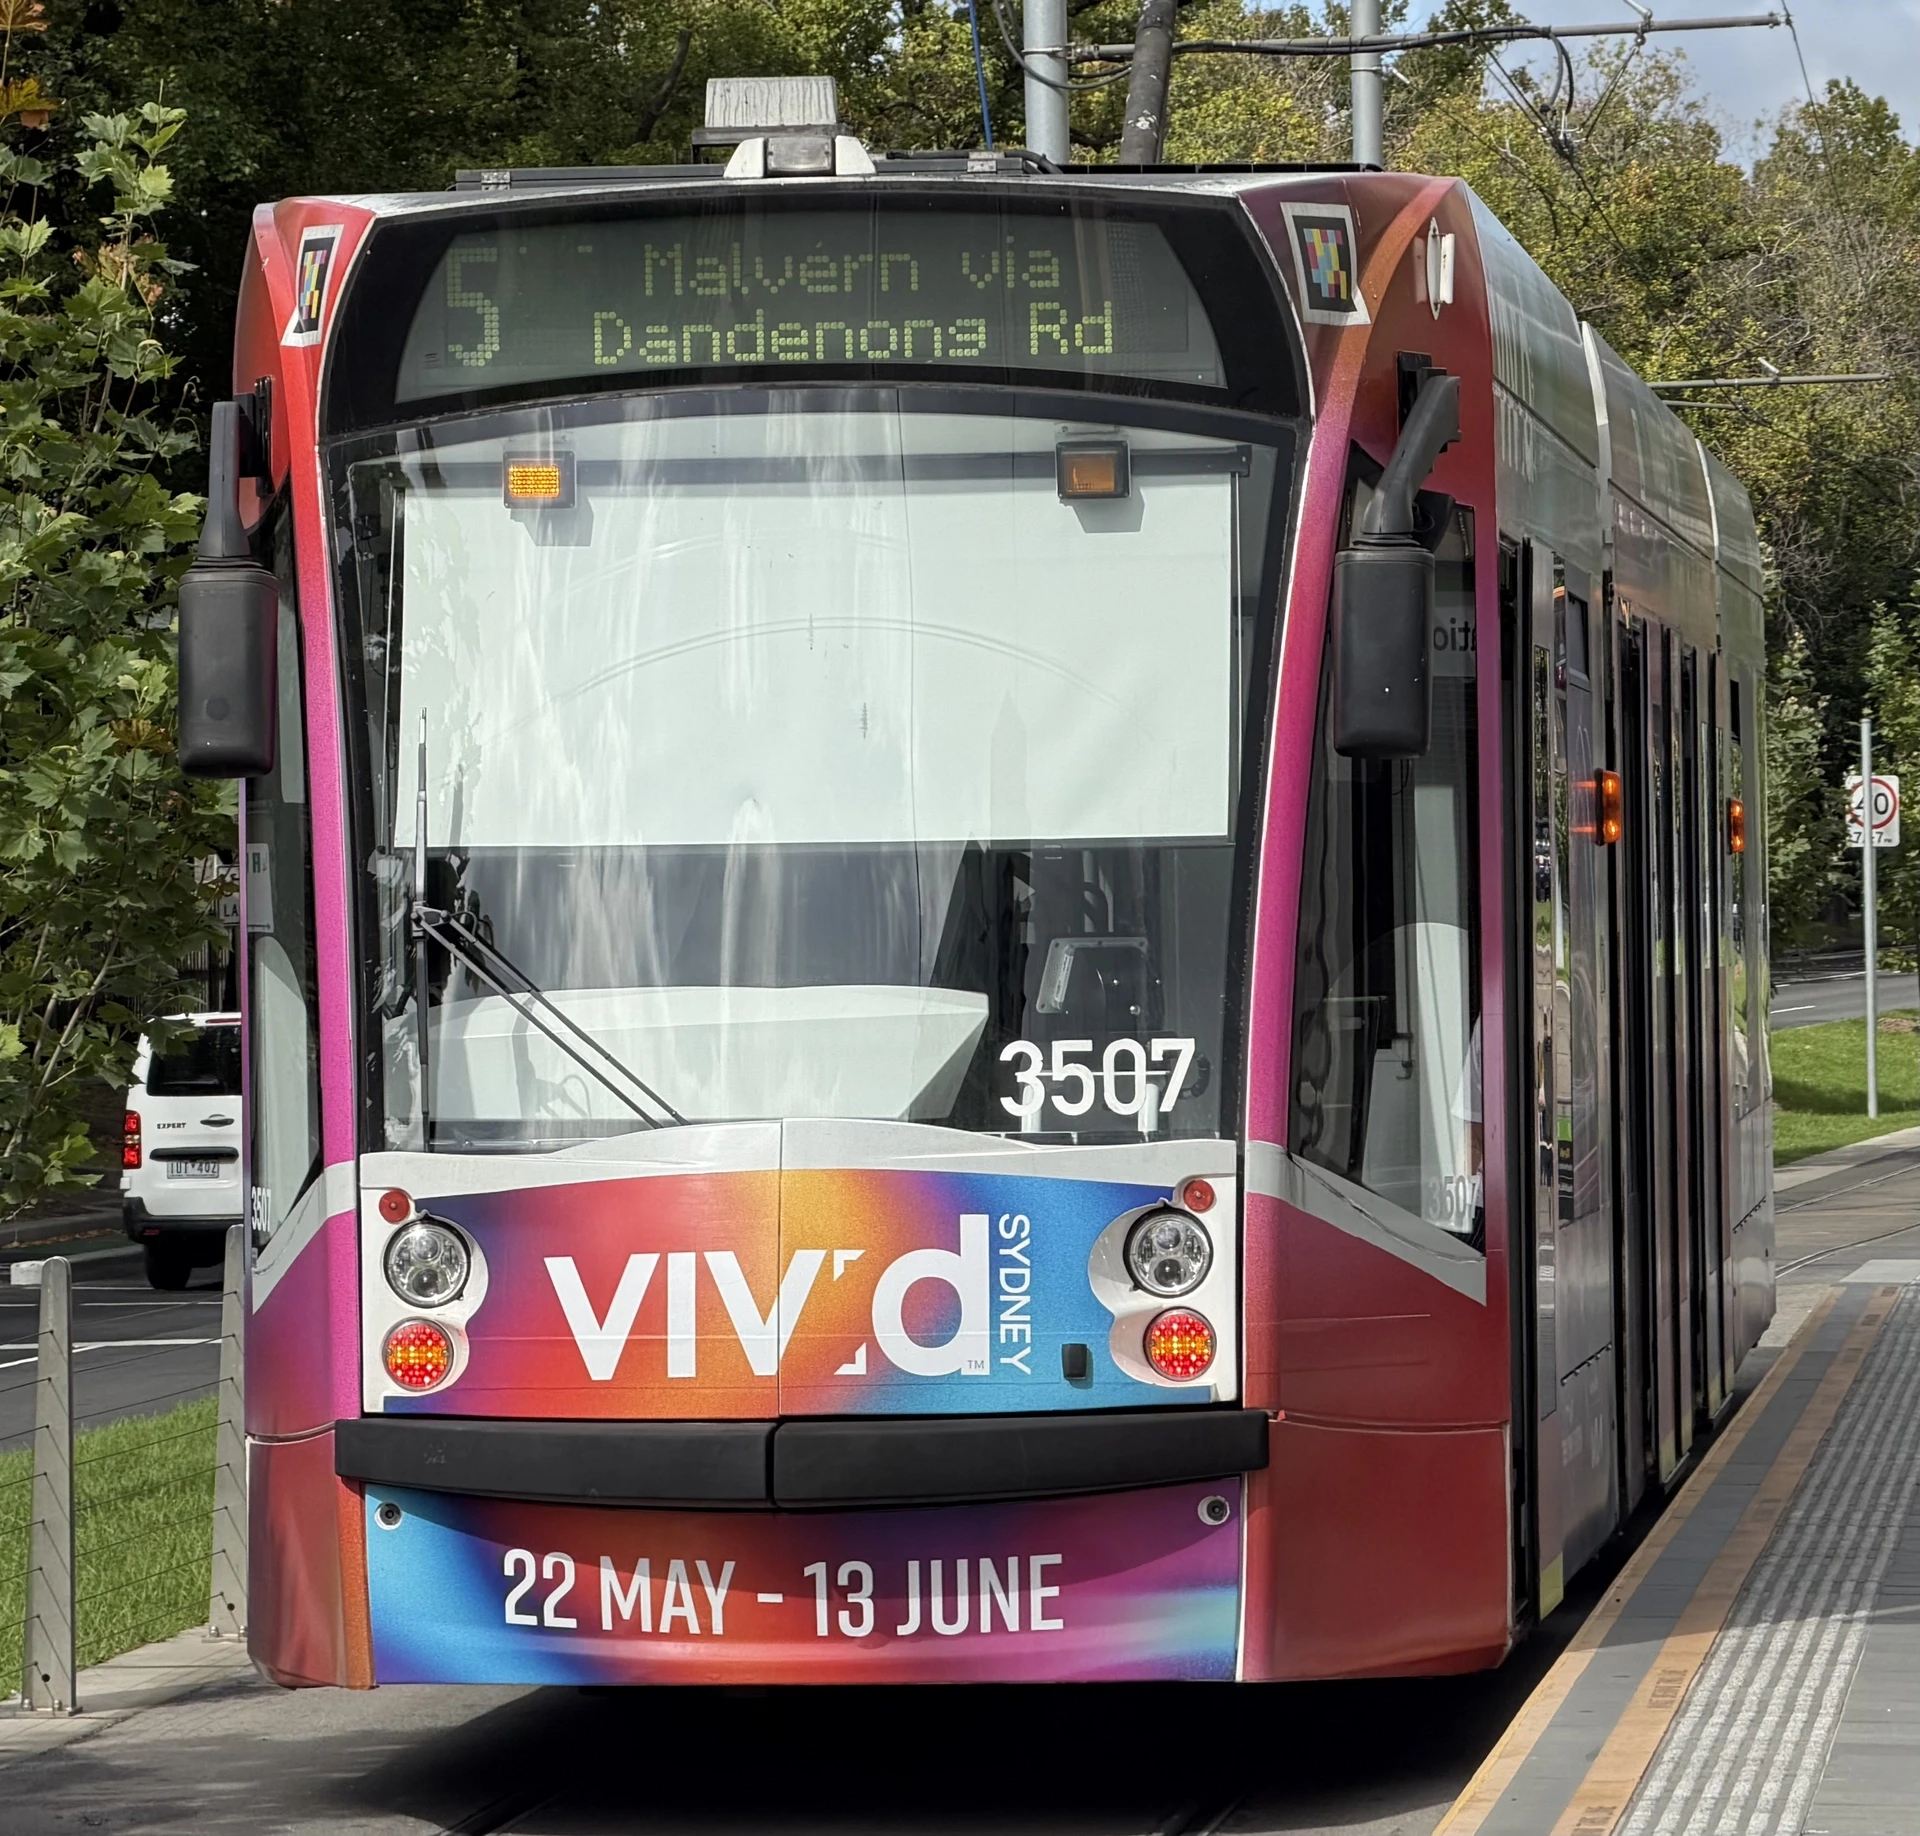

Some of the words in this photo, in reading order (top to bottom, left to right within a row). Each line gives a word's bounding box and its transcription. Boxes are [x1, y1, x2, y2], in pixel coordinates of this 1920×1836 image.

[643, 242, 919, 296] Malvern
[961, 235, 1061, 290] via
[447, 247, 500, 367] 5
[594, 308, 987, 365] Dandenong
[1029, 301, 1114, 356] Rd
[999, 1037, 1196, 1117] 3507
[156, 1122, 187, 1130] EXPERT
[252, 1185, 272, 1232] 3507
[998, 1212, 1032, 1376] SYDNEY
[967, 1360, 985, 1370] TM
[502, 1548, 578, 1630] 22
[600, 1555, 736, 1637] MAY
[802, 1559, 876, 1638] 13
[897, 1553, 1065, 1637] JUNE
